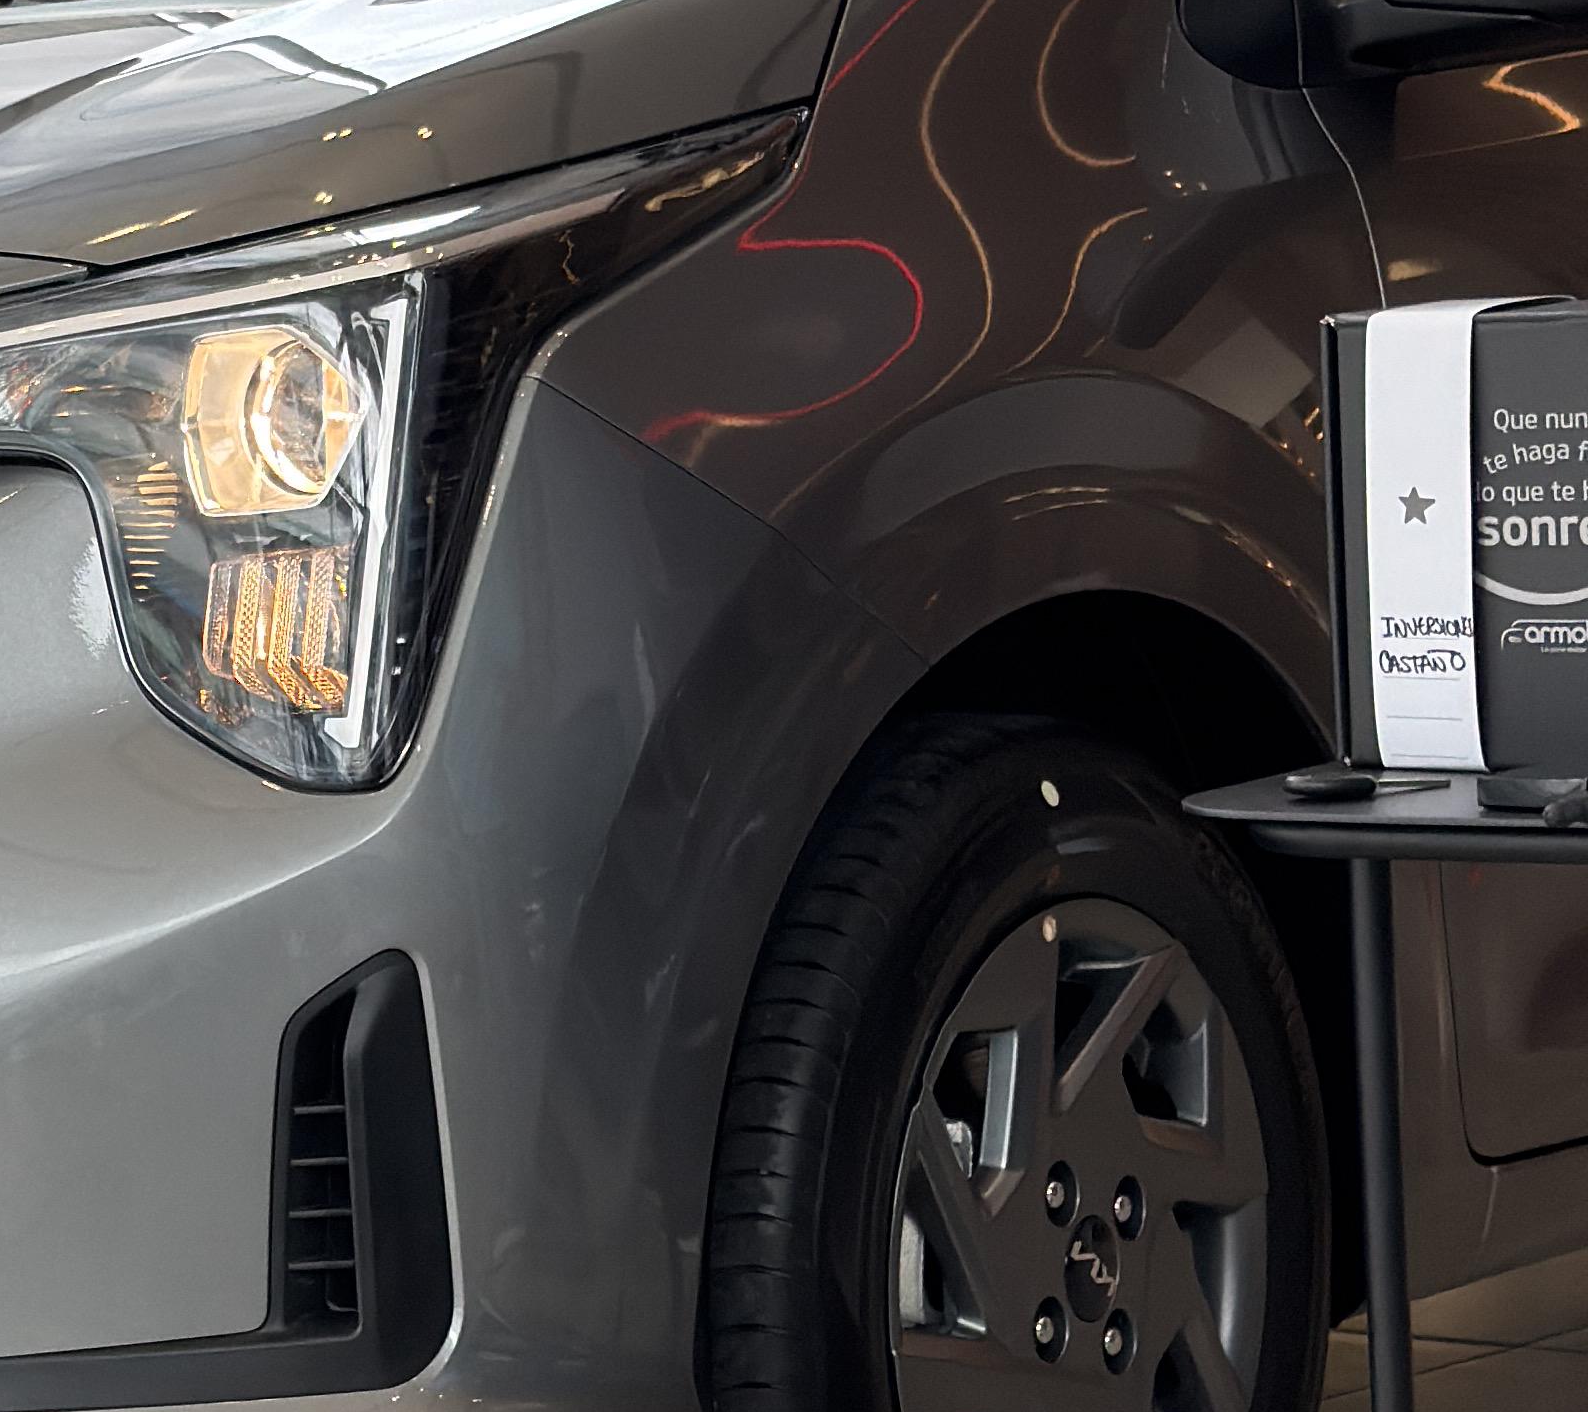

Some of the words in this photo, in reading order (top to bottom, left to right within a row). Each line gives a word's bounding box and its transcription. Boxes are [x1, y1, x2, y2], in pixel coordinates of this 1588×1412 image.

[1493, 408, 1538, 433] Que
[1483, 455, 1508, 474] te
[1513, 443, 1570, 465] haga
[1476, 481, 1495, 502] lo
[1502, 485, 1544, 507] que
[1551, 481, 1576, 502] te
[1070, 1241, 1117, 1297] KIA
